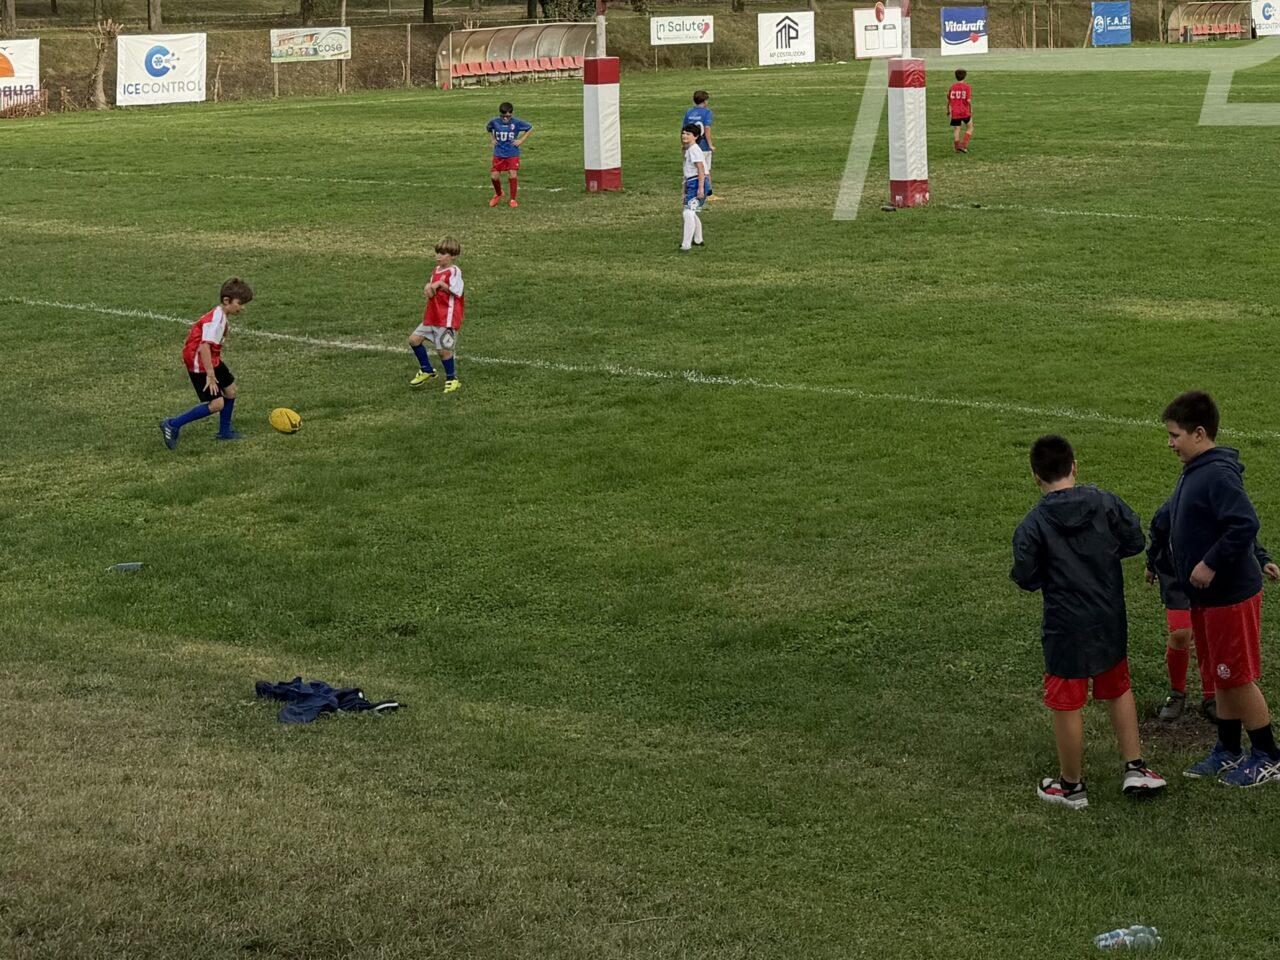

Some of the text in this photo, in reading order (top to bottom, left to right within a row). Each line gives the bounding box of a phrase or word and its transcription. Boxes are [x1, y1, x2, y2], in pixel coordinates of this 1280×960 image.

[667, 20, 704, 32] Salute
[945, 19, 984, 32] Vitakraft
[0, 84, 35, 100] qua
[123, 80, 202, 95] ICECONTROL
